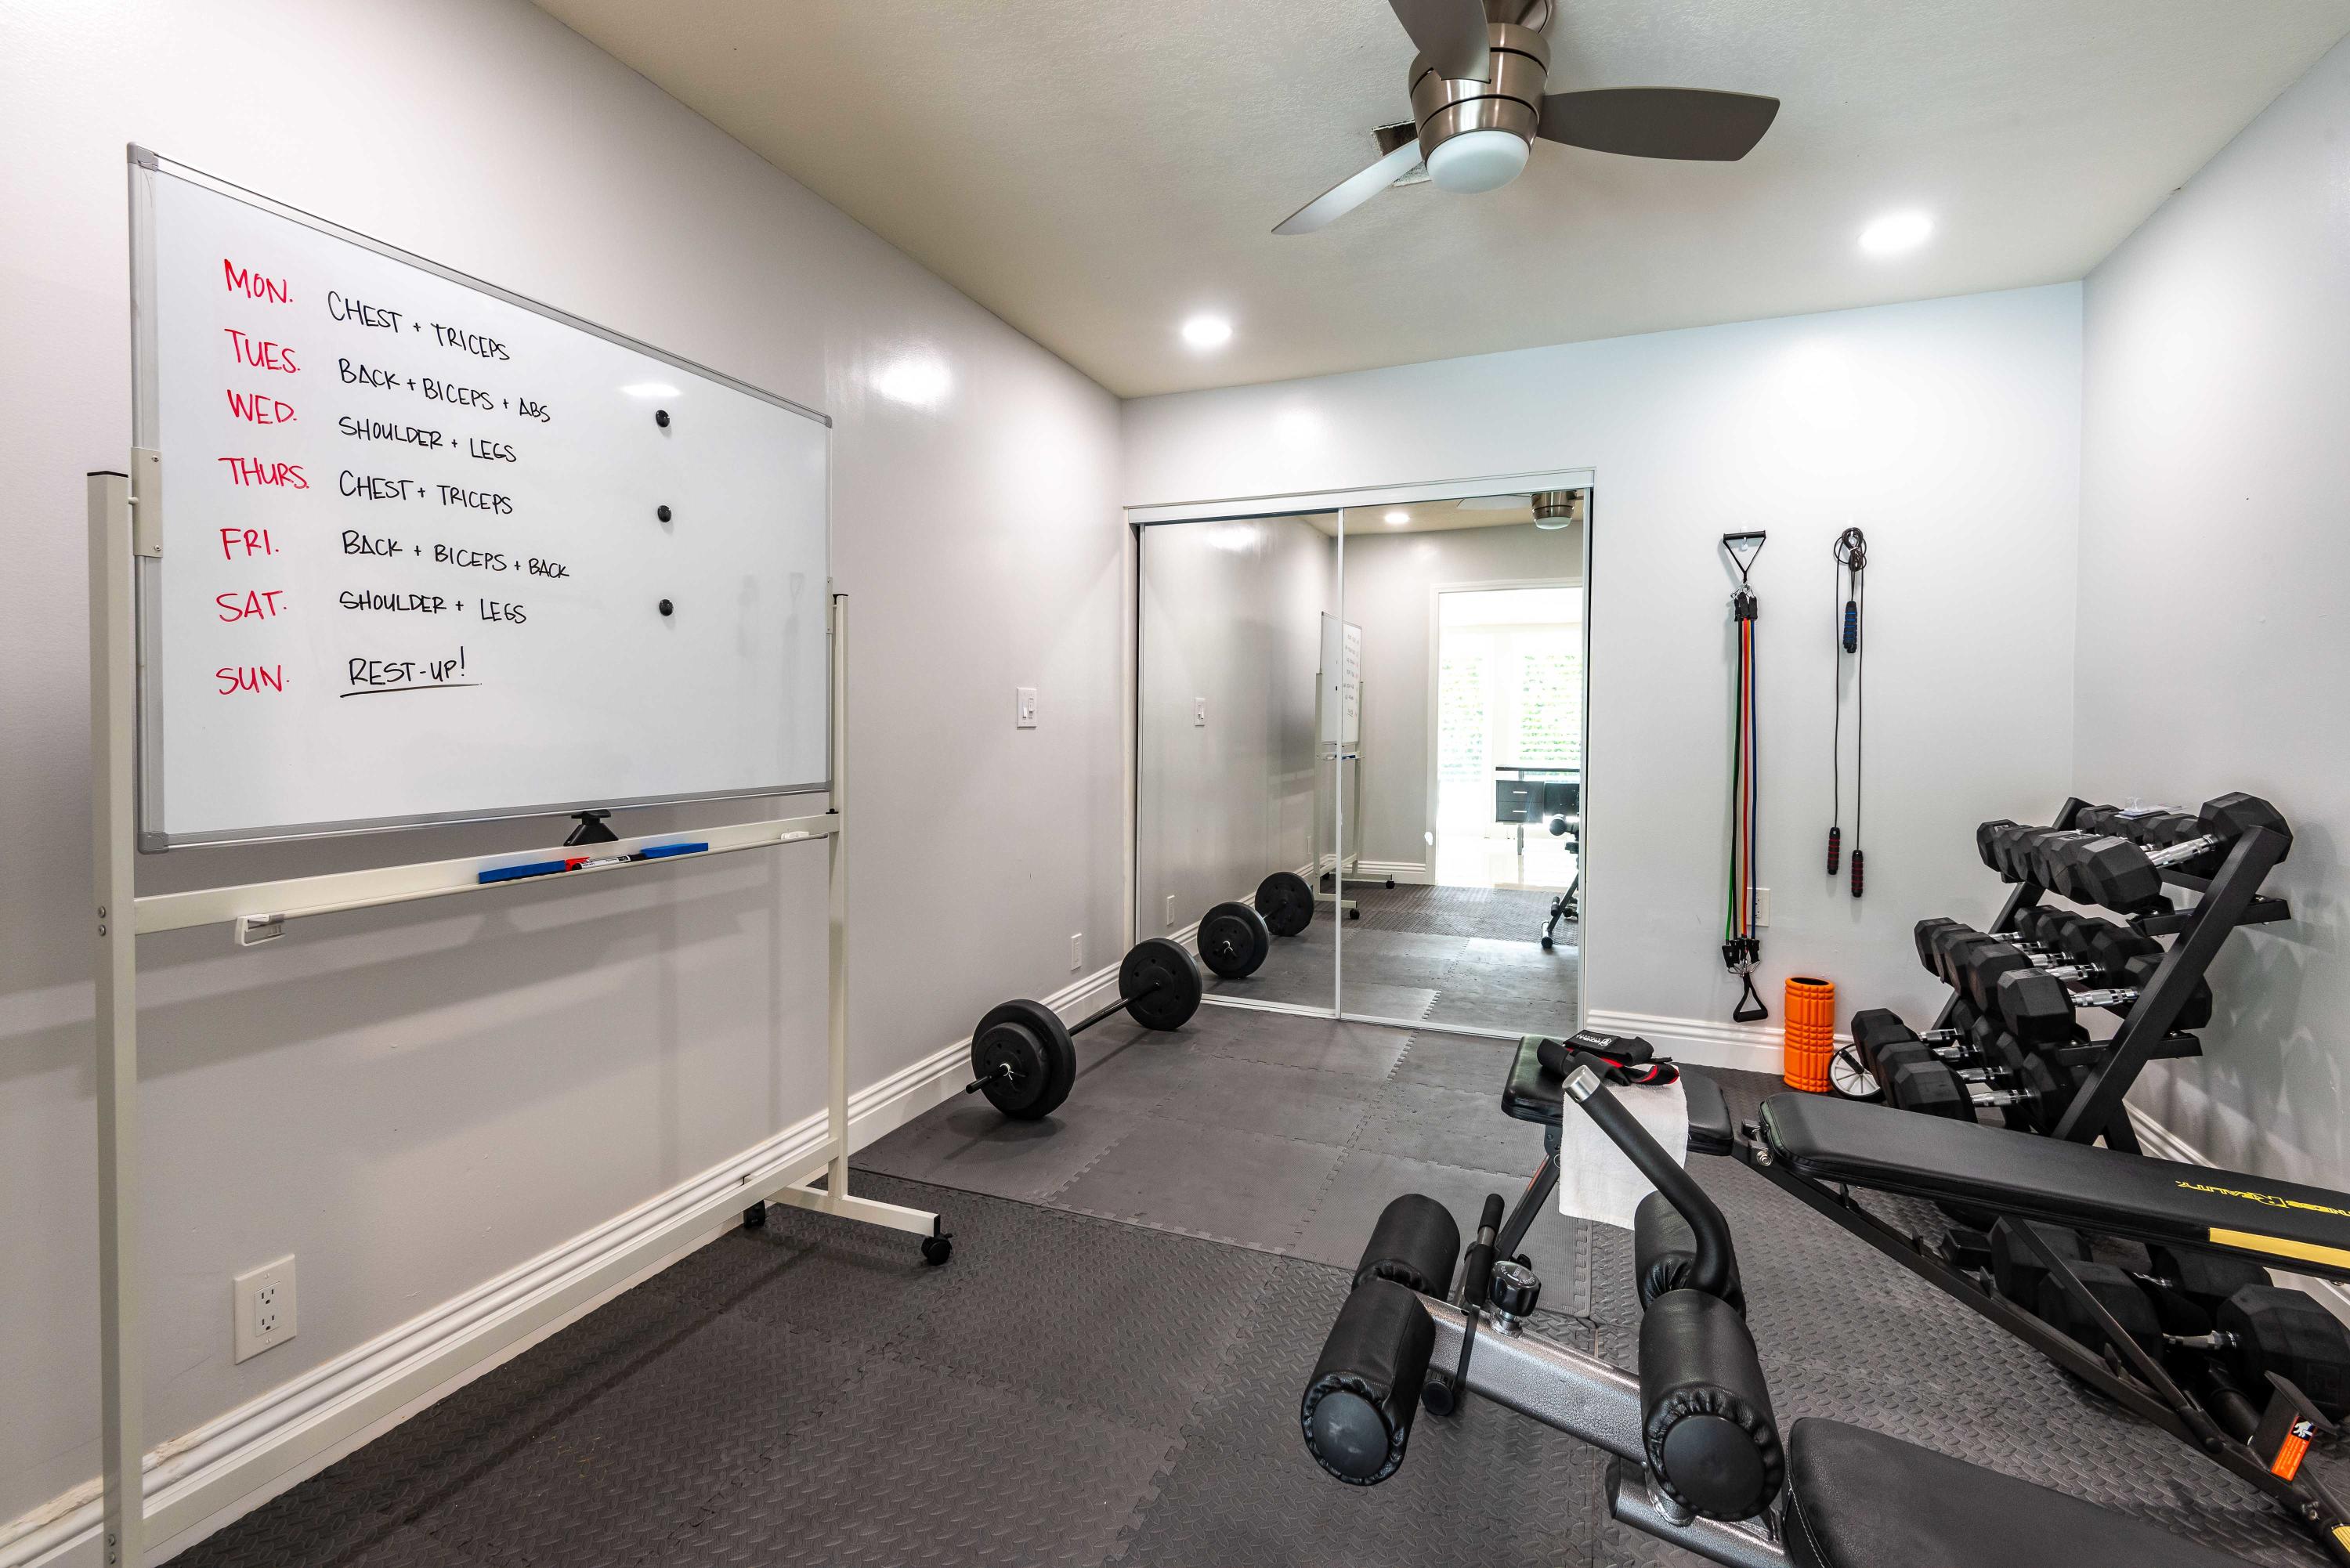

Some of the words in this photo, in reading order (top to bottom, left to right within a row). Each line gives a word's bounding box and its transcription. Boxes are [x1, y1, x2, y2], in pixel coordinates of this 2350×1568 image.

[224, 259, 293, 304] MON.
[328, 291, 403, 334] CHEST
[412, 322, 421, 333] +
[430, 323, 511, 361] TRICEPS
[224, 328, 301, 374] TUES.
[227, 389, 297, 425] WED.
[338, 358, 401, 391] BACK
[407, 378, 417, 392] +
[423, 378, 494, 410] BICEPS
[502, 398, 511, 410] +
[519, 397, 551, 424] ABS
[338, 416, 443, 450] SHOULDER
[450, 439, 458, 449] +
[470, 438, 517, 463] LEGS
[218, 457, 309, 490] THURS.
[340, 470, 414, 501] CHEST
[417, 486, 426, 498] +
[436, 485, 513, 515] TRICEPS
[220, 528, 279, 561] FRI.
[342, 530, 403, 558] BACK
[413, 544, 422, 557] +
[434, 544, 508, 572] BICEPS
[513, 560, 522, 572] +
[529, 558, 570, 579] BACK
[216, 591, 287, 623] SAT.
[339, 590, 447, 615] SHOULDER
[454, 599, 465, 612] +
[480, 598, 527, 624] LEGS
[216, 664, 289, 695] SUN.
[349, 646, 467, 685] REST-UP!
